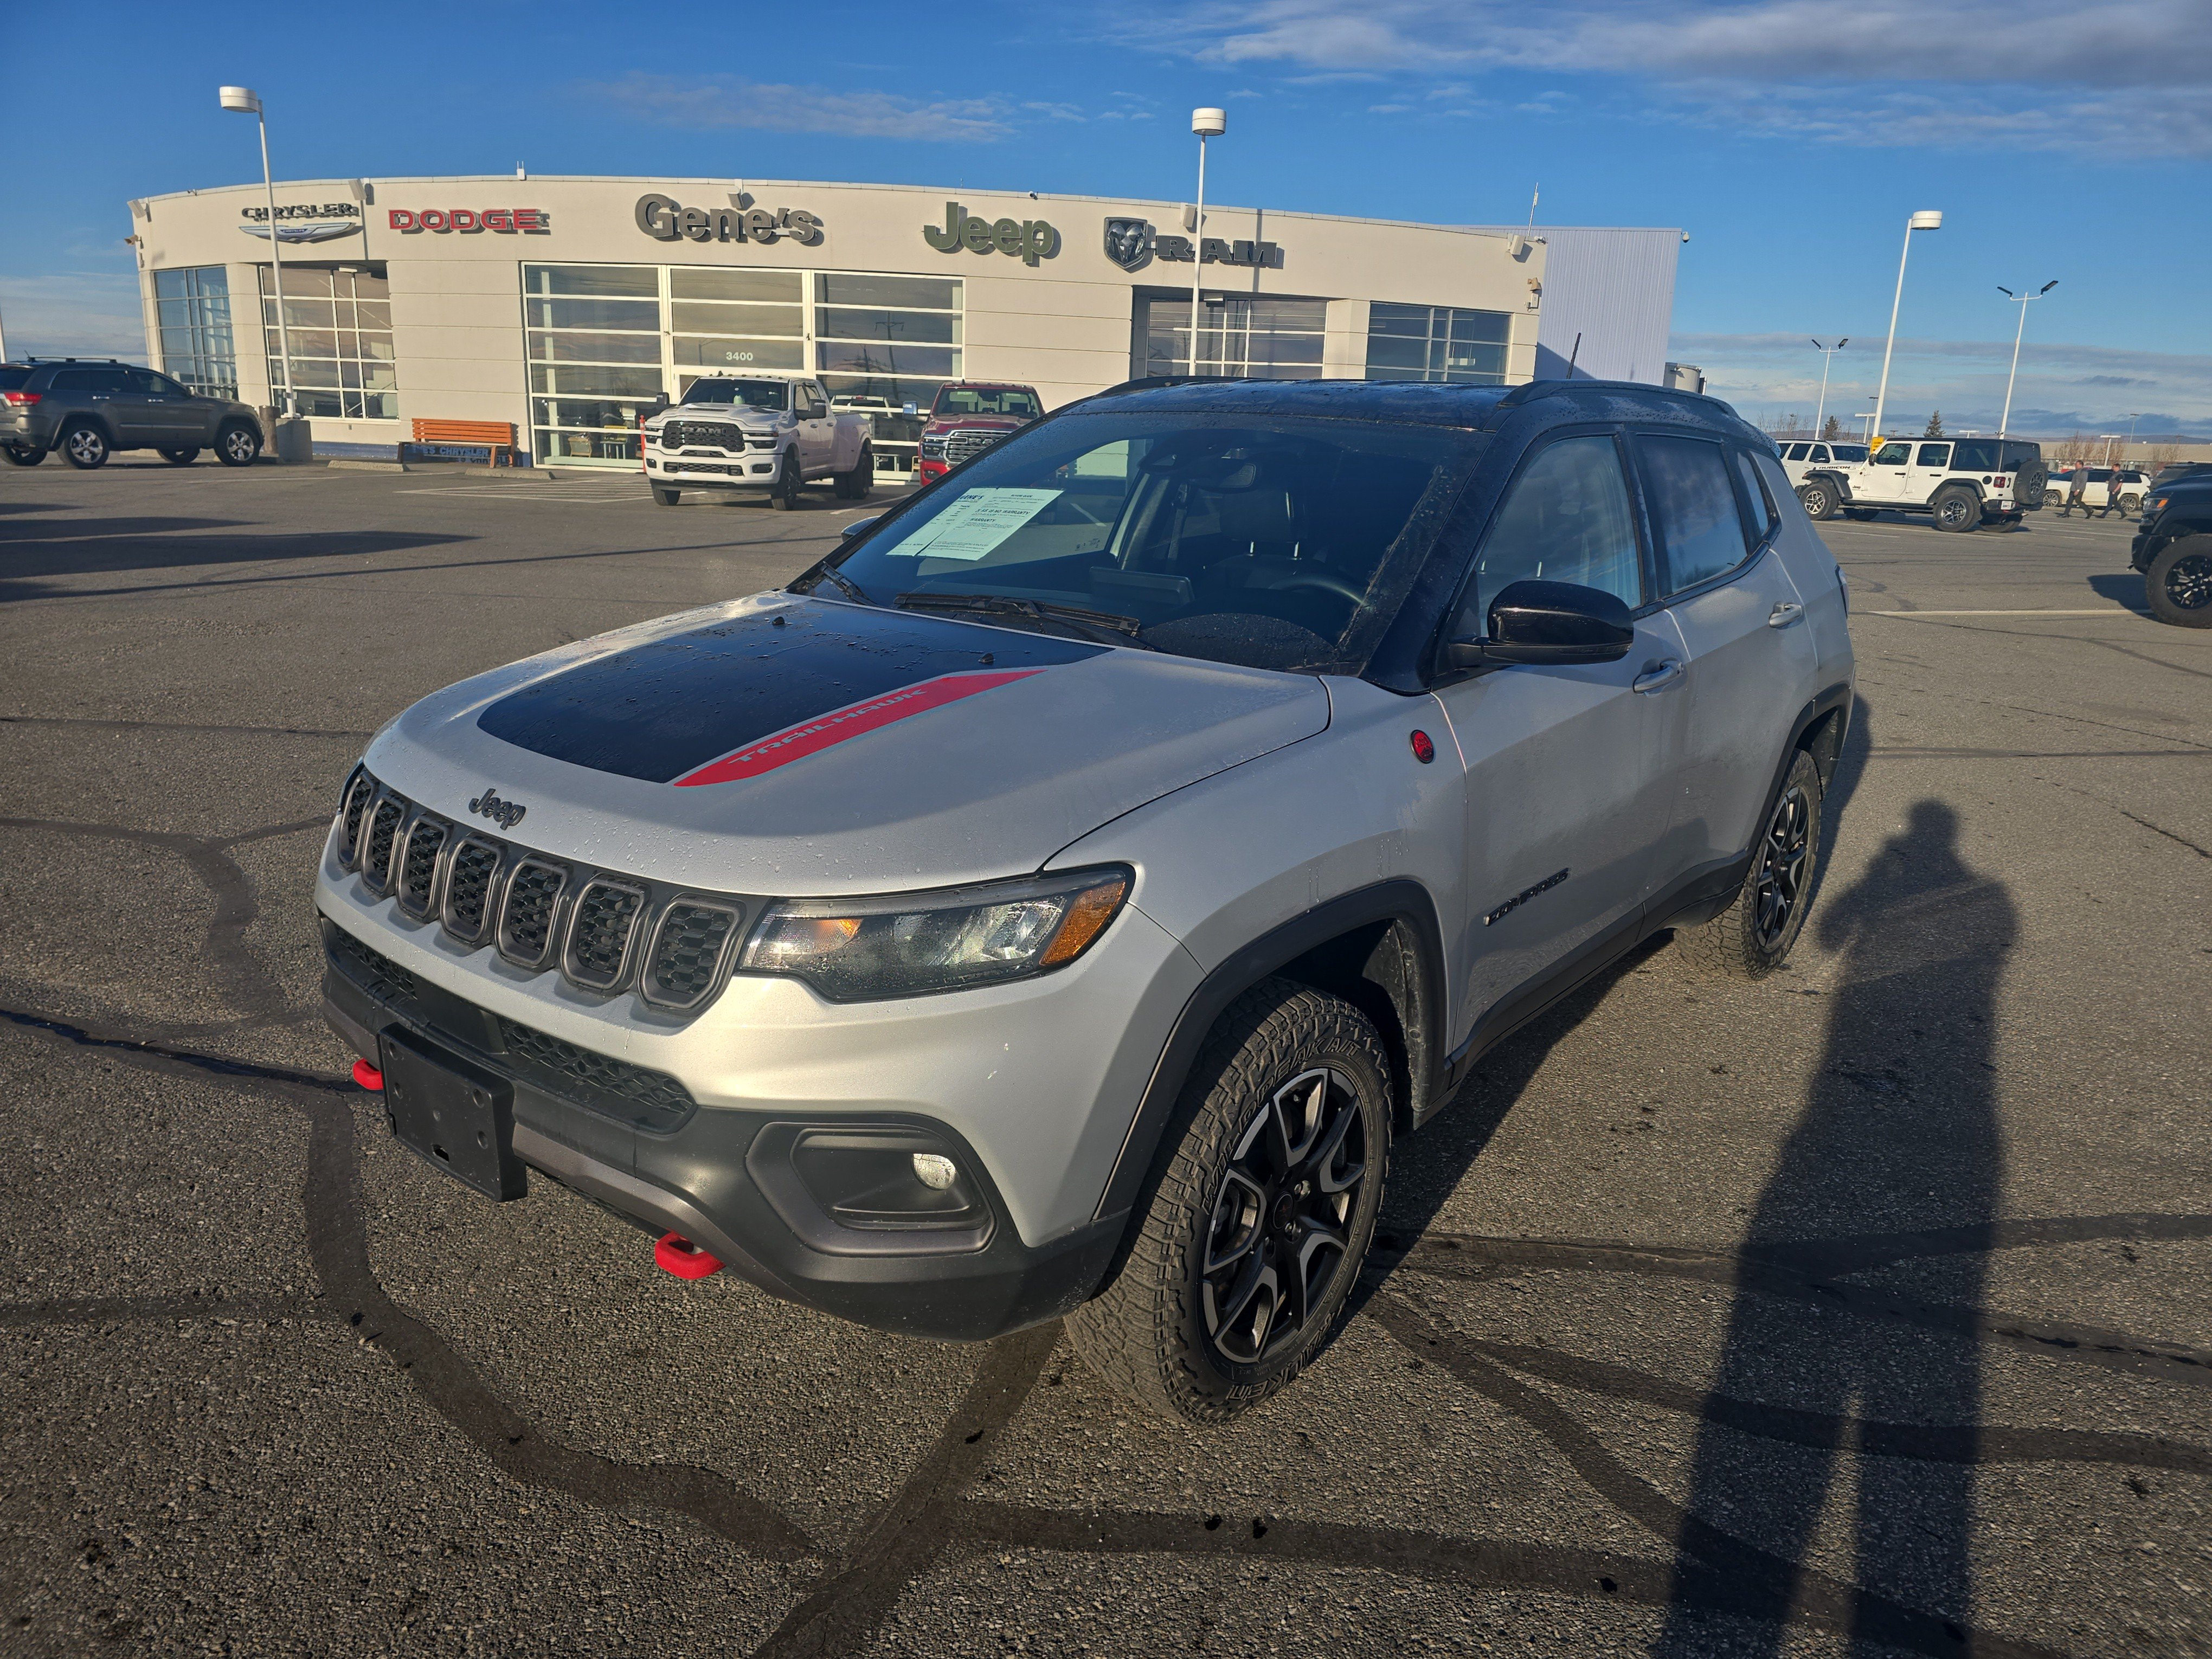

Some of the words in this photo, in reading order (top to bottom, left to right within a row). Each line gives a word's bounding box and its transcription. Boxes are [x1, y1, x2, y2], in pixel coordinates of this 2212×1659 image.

[241, 203, 355, 218] CHRYSLER
[388, 209, 539, 230] DODGE
[635, 193, 814, 241] Gene's
[923, 201, 1054, 263] Jeep
[1156, 235, 1277, 263] RAM
[726, 351, 754, 361] 3400
[681, 426, 722, 435] RAM
[728, 689, 927, 764] TRAILHAWK
[468, 788, 526, 831] Jeep
[1201, 1037, 1326, 1216] WILDPEAK
